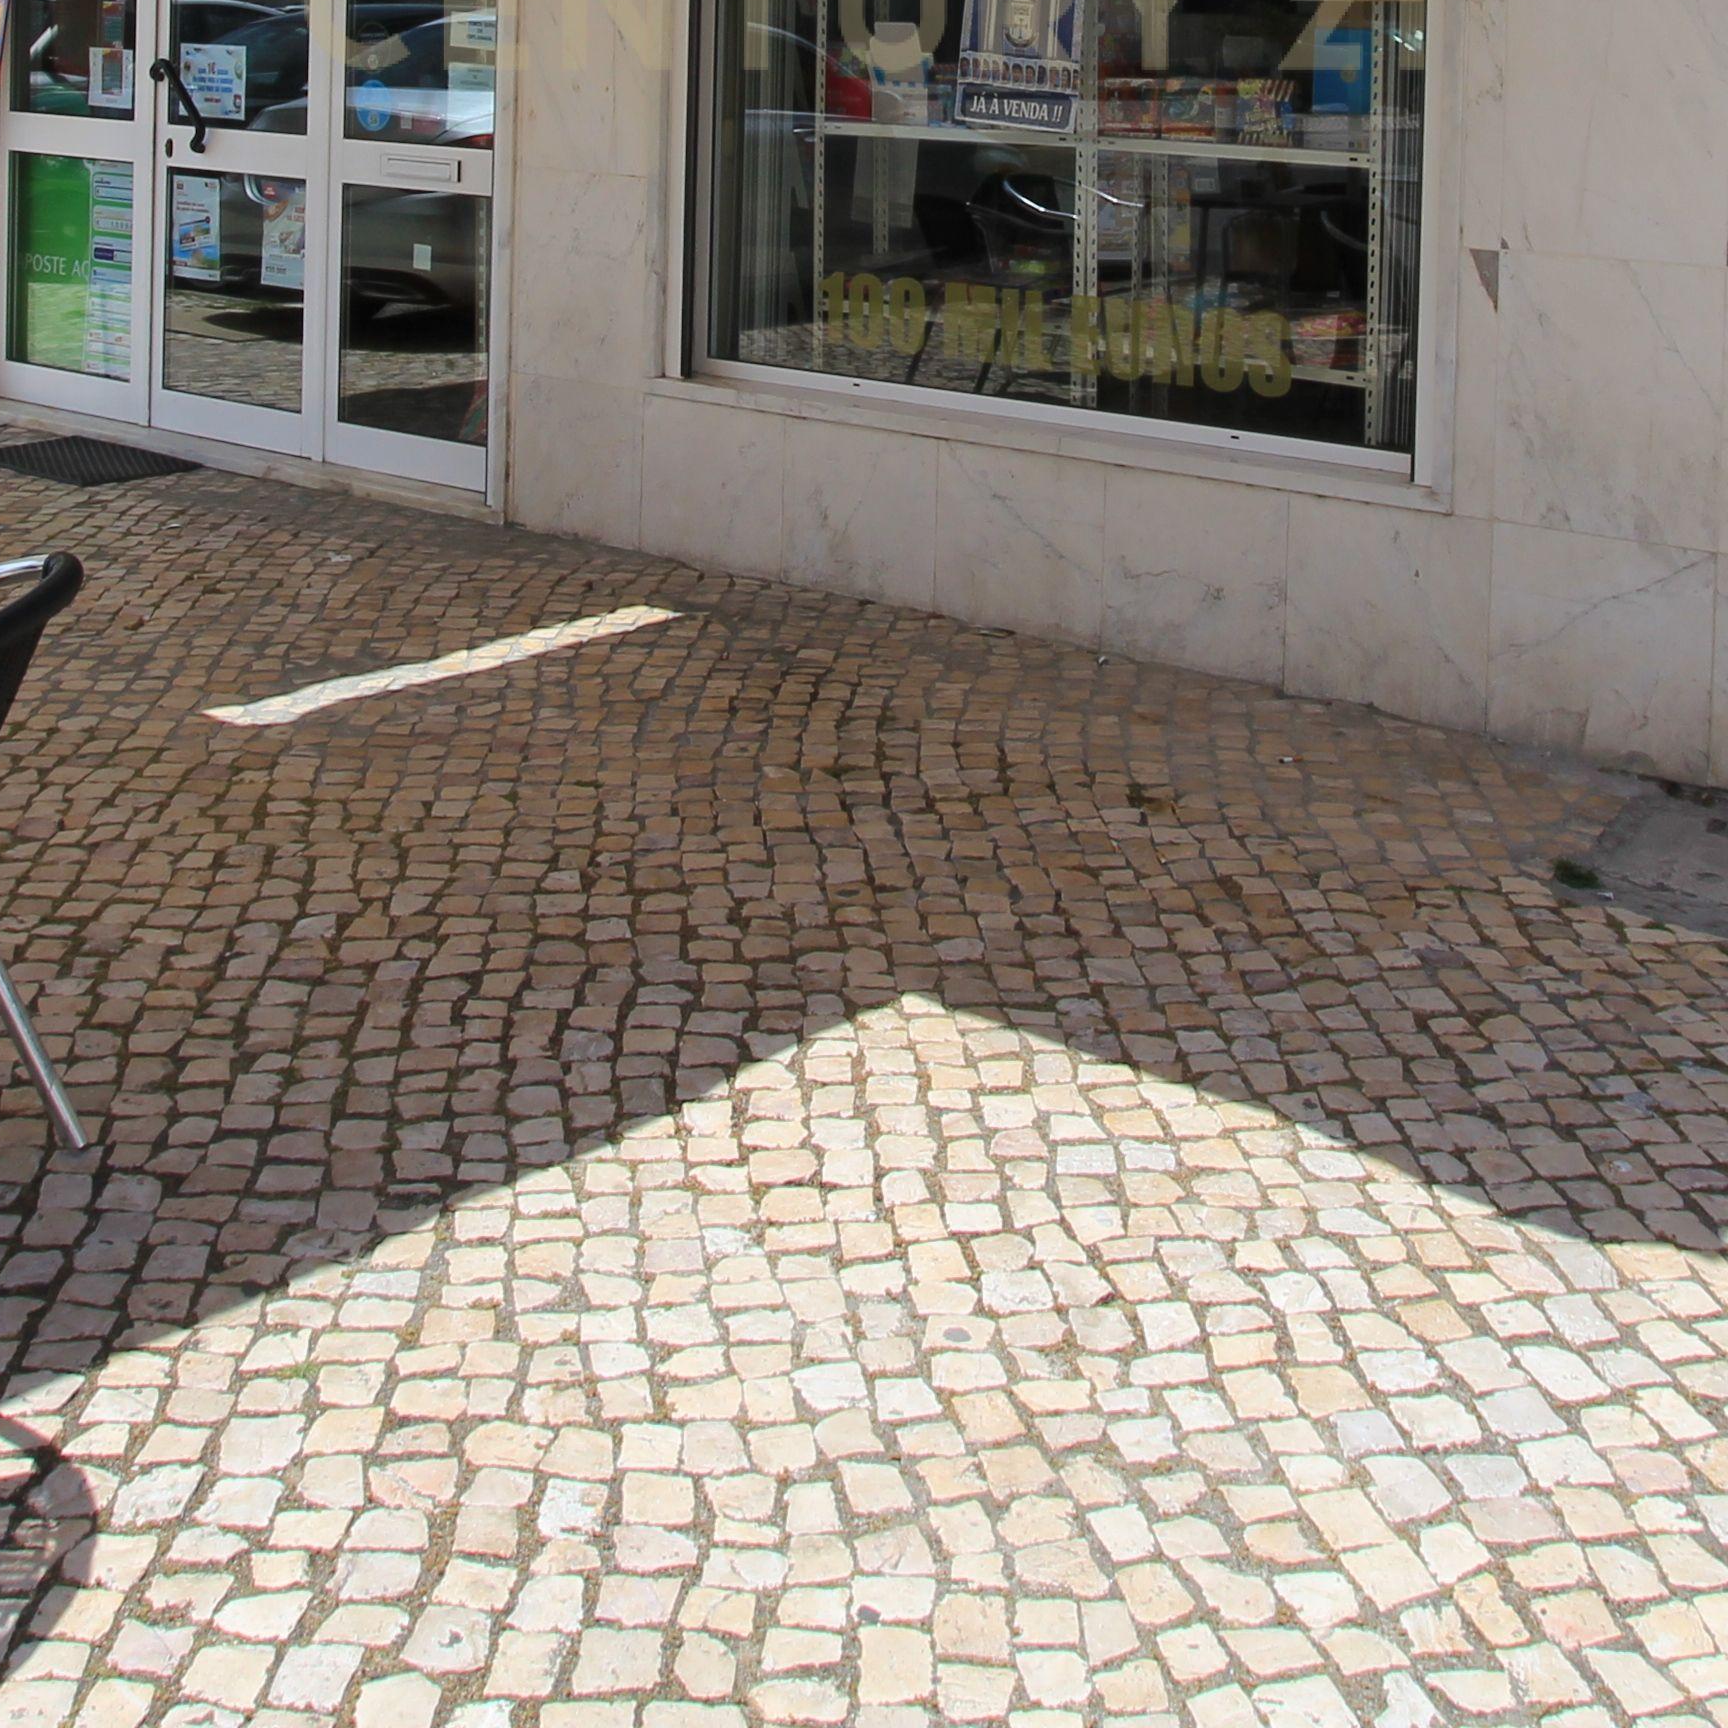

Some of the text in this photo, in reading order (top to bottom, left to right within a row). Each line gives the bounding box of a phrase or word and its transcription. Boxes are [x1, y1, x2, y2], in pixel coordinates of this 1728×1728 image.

[970, 88, 987, 114] JÁ
[989, 92, 1000, 115] À
[1003, 98, 1050, 121] VENDA
[821, 271, 926, 356] 100
[943, 281, 1051, 372] MIL
